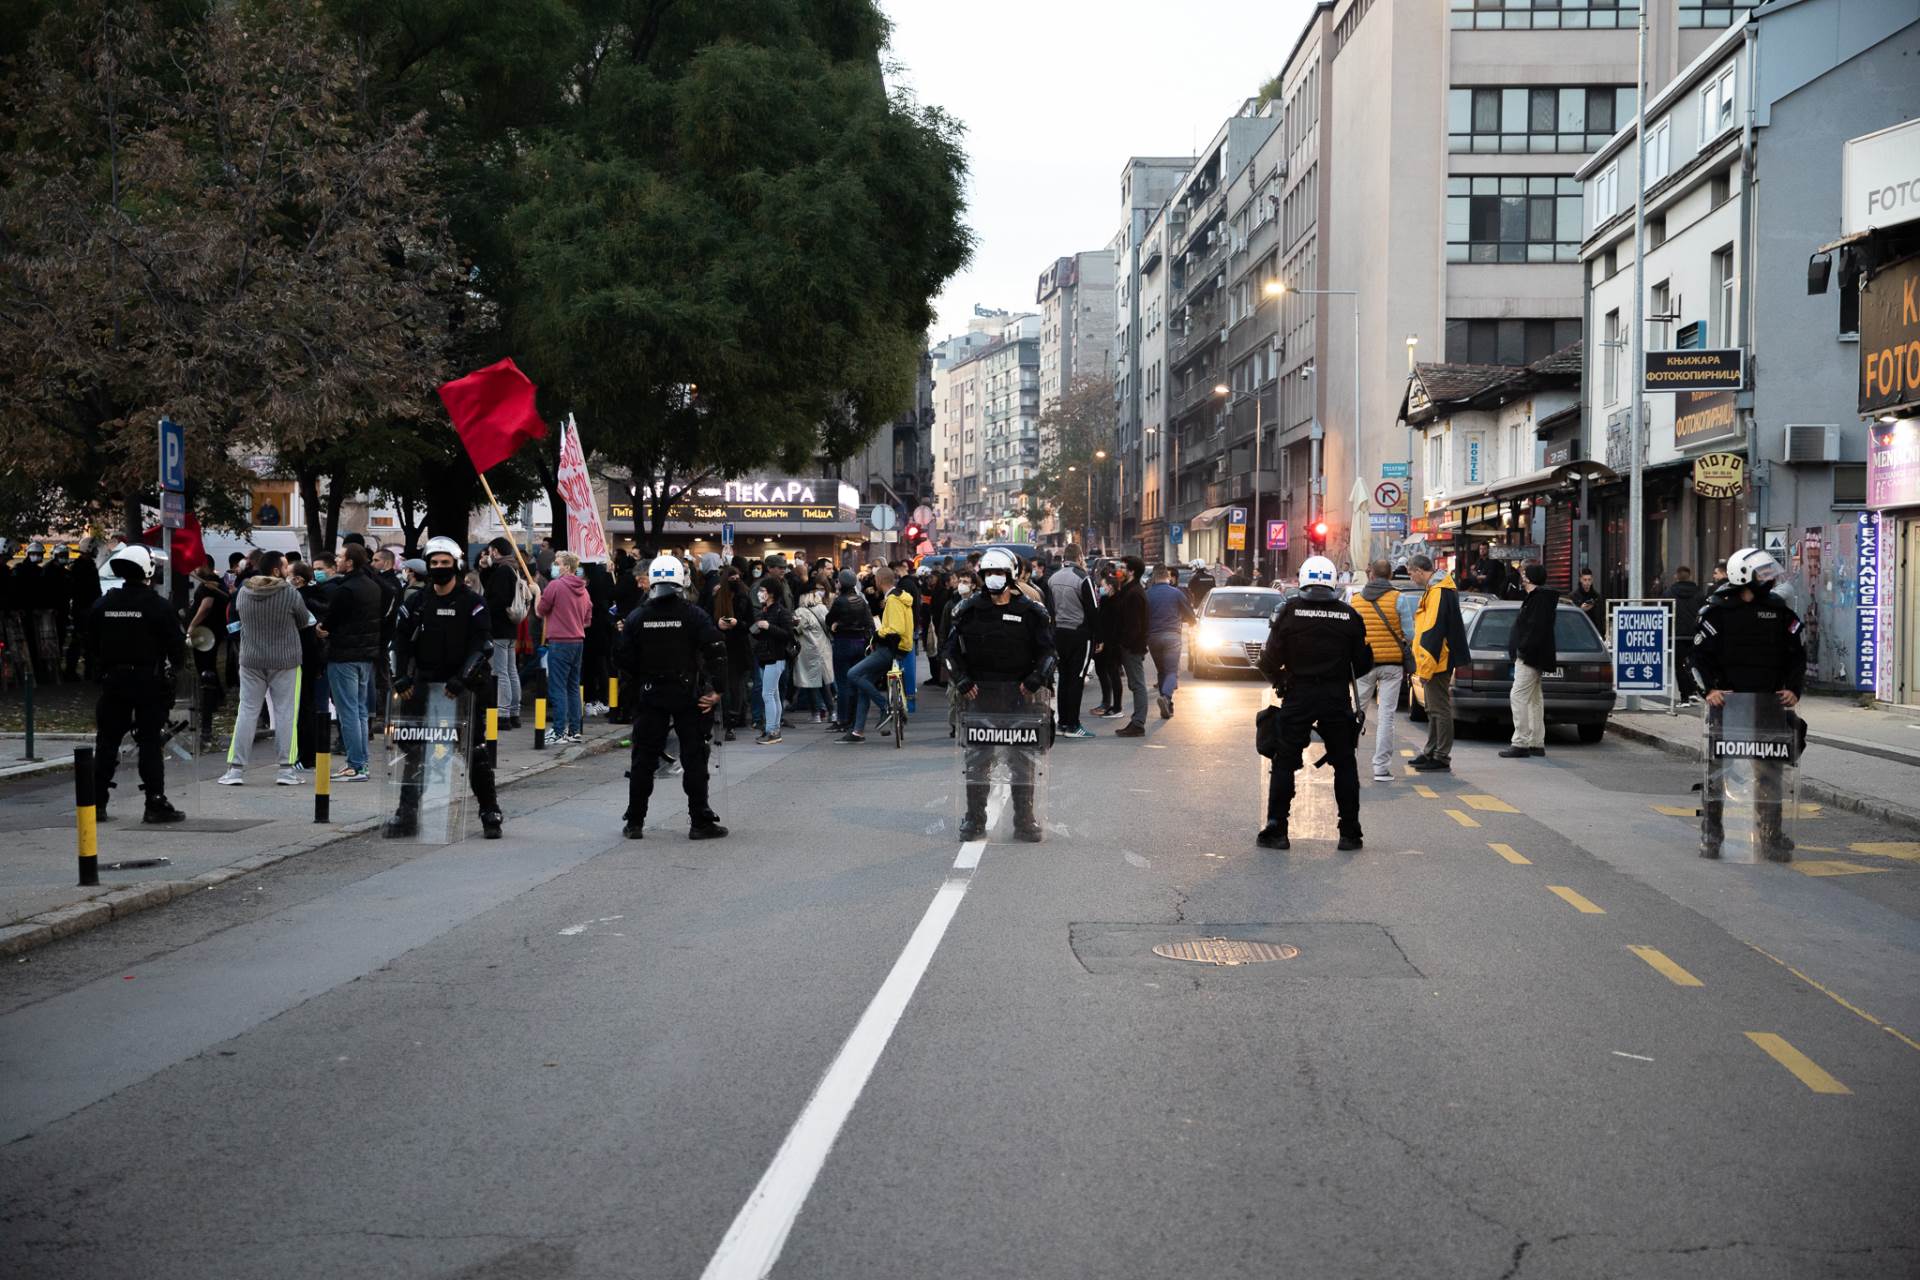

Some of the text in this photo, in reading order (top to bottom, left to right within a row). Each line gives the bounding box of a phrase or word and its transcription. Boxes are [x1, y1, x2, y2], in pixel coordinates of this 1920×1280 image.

[1667, 356, 1721, 365] КЊИЖАРА
[1647, 370, 1741, 381] ФОТОКОПИРНИЦА
[165, 432, 179, 480] P
[1698, 455, 1741, 470] MOTO
[1233, 510, 1243, 523] P
[1860, 514, 1879, 524] € $
[1172, 525, 1181, 536] P
[1859, 527, 1876, 605] EXCHANGE
[1619, 614, 1663, 629] EXCHANGE
[1626, 631, 1655, 647] OFFICE
[1619, 649, 1661, 664] MENJAČNICA
[1625, 665, 1653, 679] € $
[393, 728, 459, 742] ПОЛИЦИЈА
[968, 728, 1037, 744] ПОЛИЦИЈА
[1716, 741, 1789, 758] ПОЛИЦИЈА
